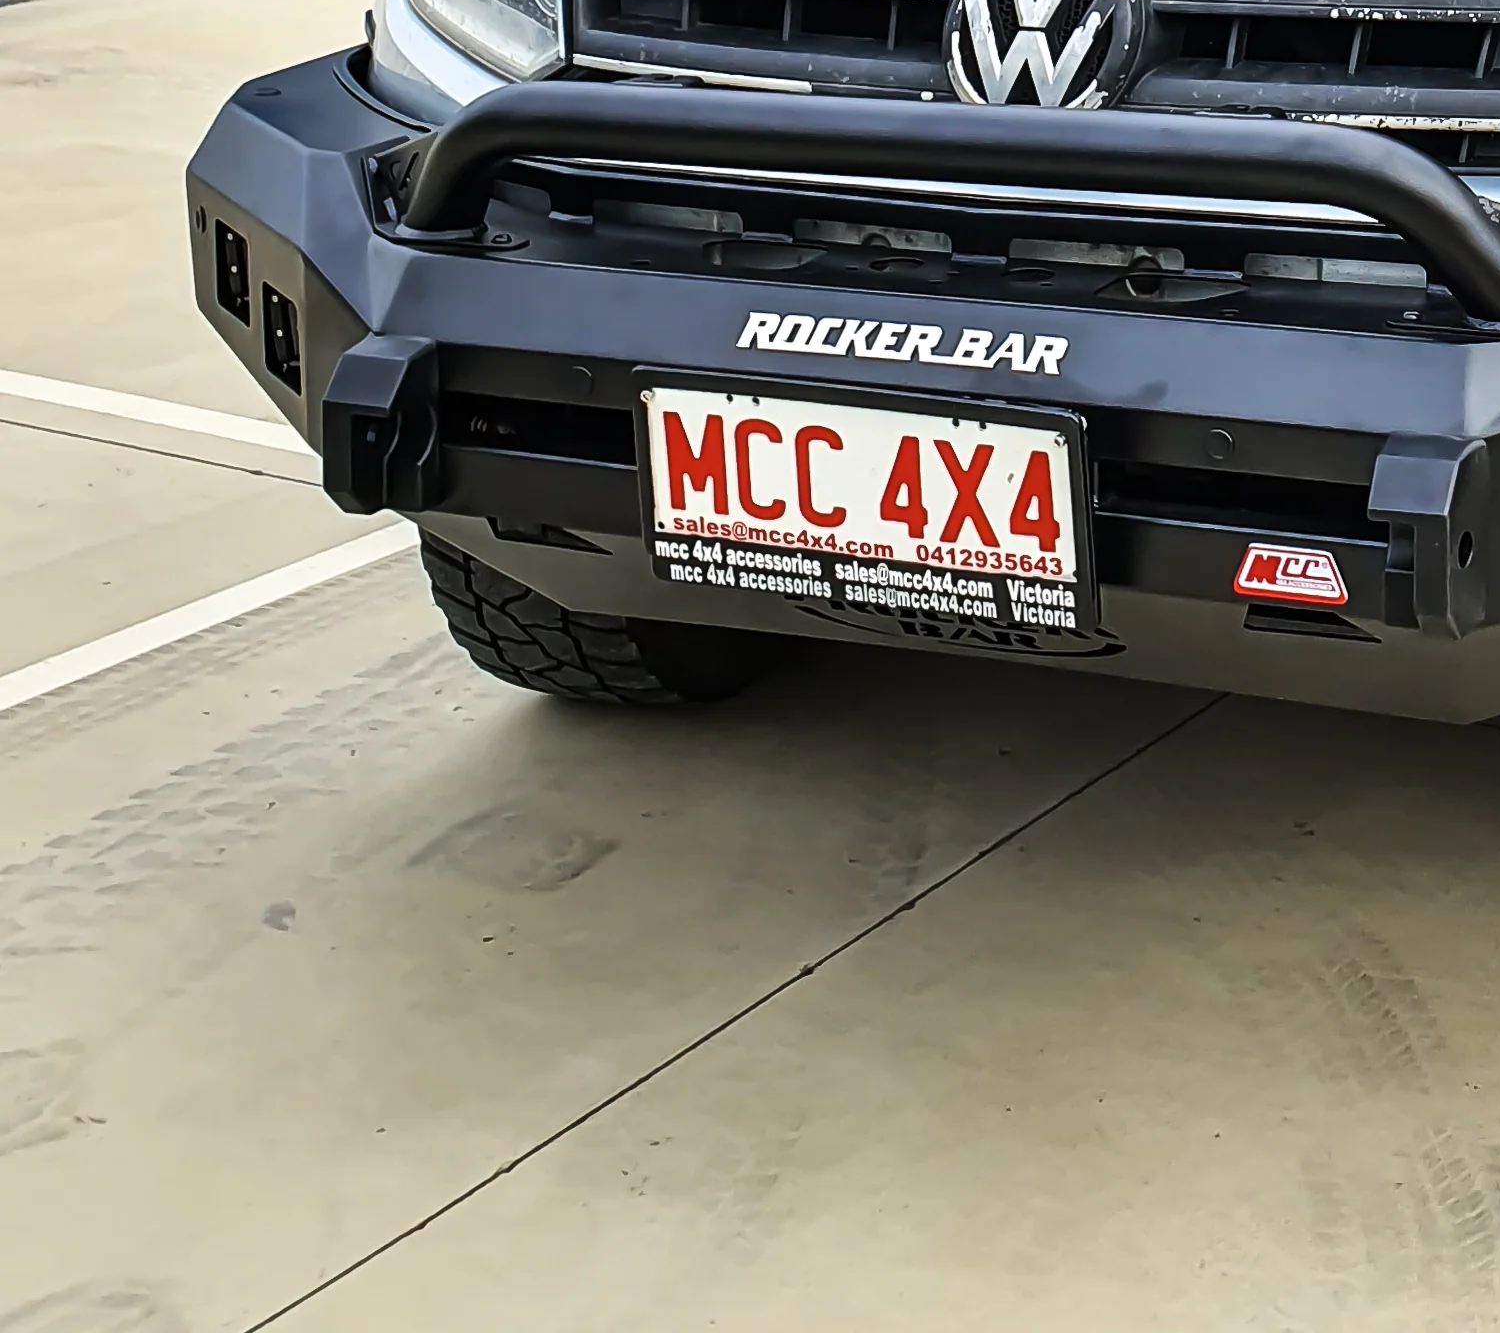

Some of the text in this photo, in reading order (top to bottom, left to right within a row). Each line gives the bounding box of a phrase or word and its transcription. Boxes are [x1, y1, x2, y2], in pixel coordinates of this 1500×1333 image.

[735, 310, 1069, 376] ROCKER BAR
[662, 410, 1061, 553] MCC 4X4
[654, 539, 1076, 608] mcc 4x4 accessories sales@mcc4x4.com Victoria
[673, 516, 1064, 576] sales@mcc4x4.com 0412935643
[1244, 553, 1332, 585] MCC
[670, 563, 703, 583] mcc
[706, 563, 735, 587] 4x4
[739, 571, 832, 598] accessories
[844, 582, 998, 619] sales@mcc4x4.com
[1010, 601, 1077, 629] Victoria
